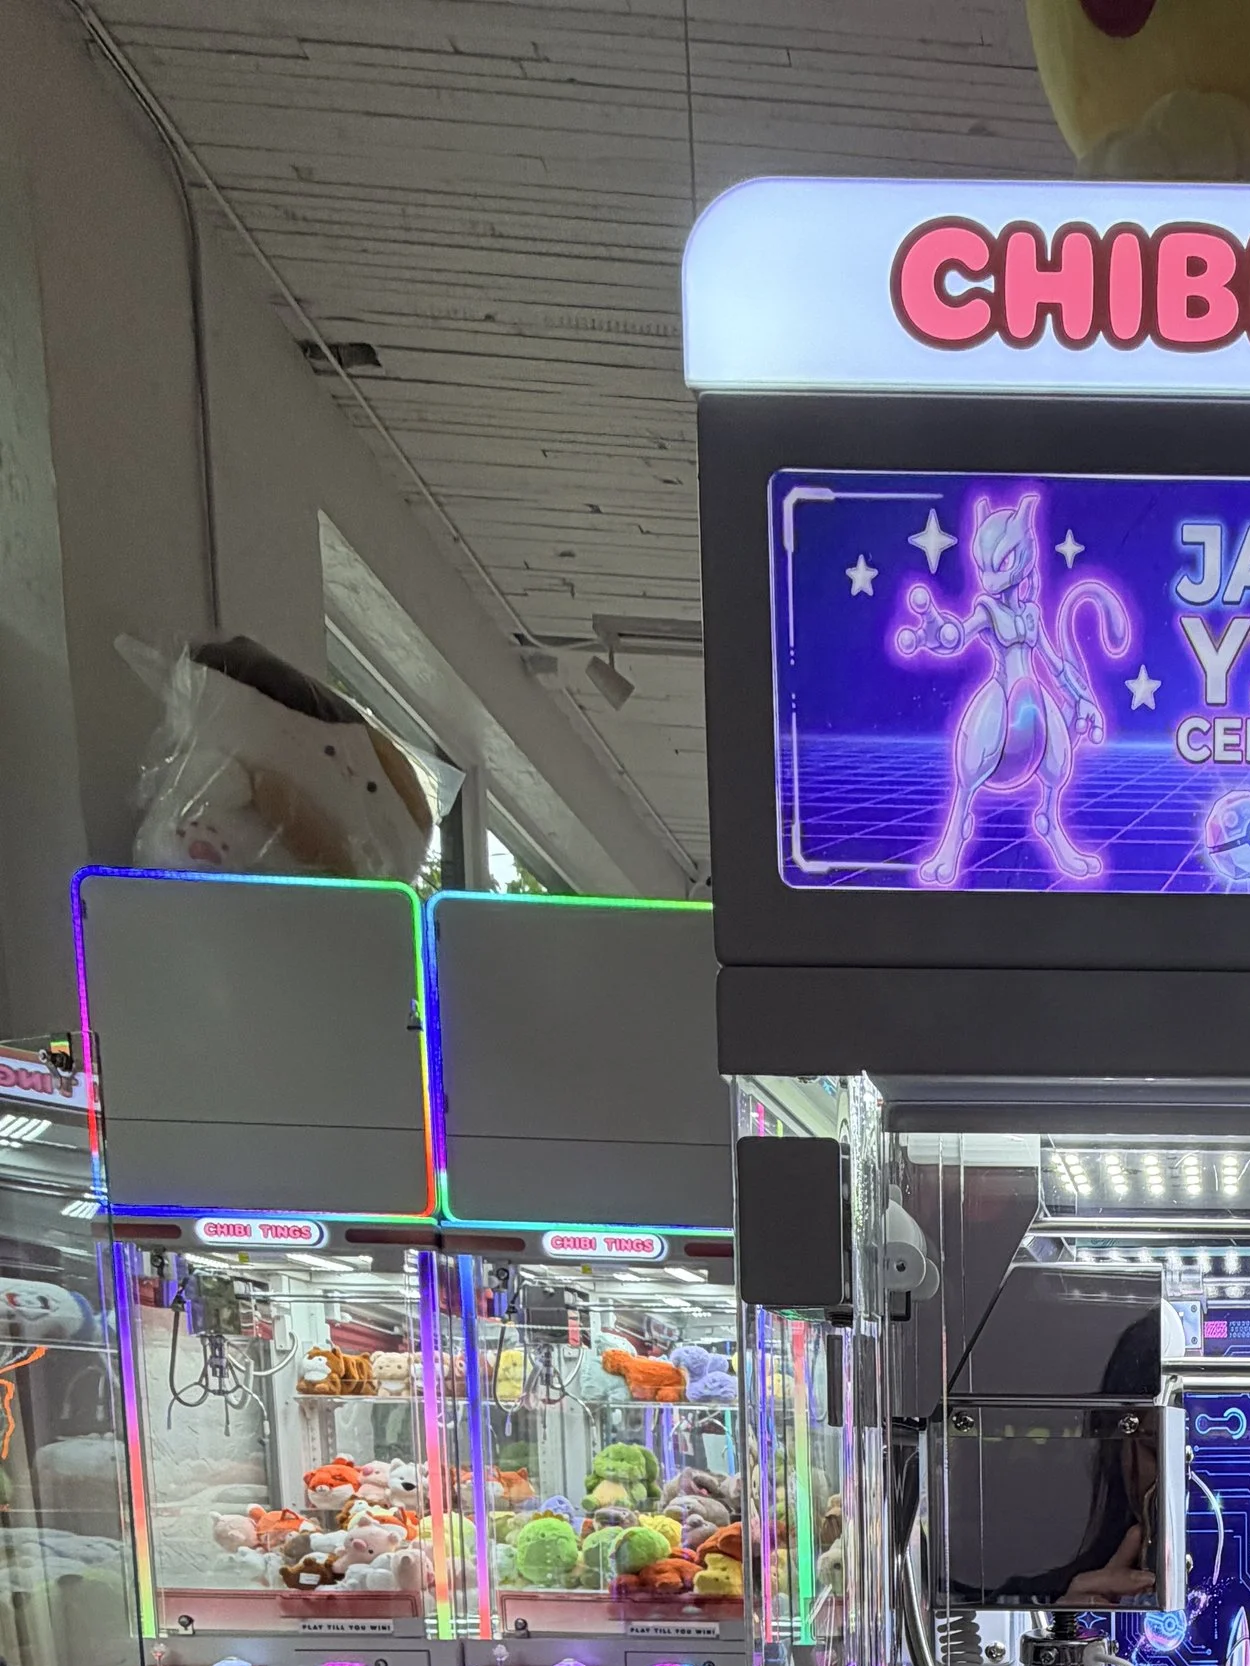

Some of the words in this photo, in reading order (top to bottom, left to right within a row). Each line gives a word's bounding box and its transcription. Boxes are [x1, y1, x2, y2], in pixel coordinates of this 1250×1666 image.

[203, 1222, 252, 1237] CHIBI
[259, 1224, 313, 1239] TINGS
[550, 1235, 597, 1251] CHIBI
[603, 1237, 655, 1253] TINGS
